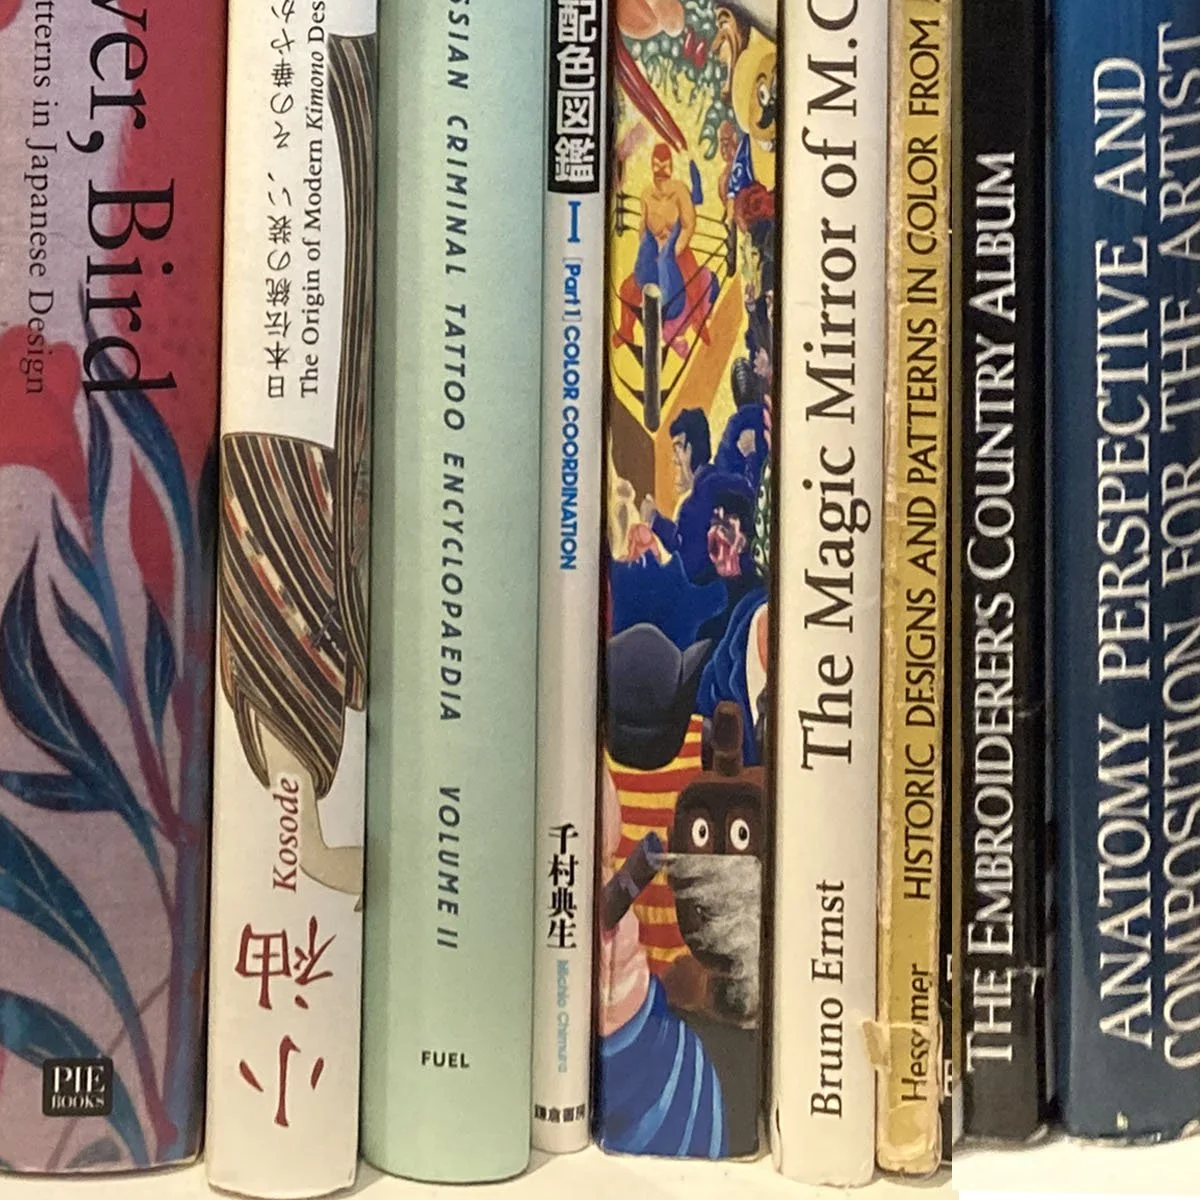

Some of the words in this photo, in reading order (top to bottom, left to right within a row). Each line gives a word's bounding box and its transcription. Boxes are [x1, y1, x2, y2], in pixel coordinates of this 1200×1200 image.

[32, 100, 58, 127] in
[305, 51, 325, 129] Kimono
[555, 0, 597, 183] 配色図鑑
[909, 17, 939, 117] FROM
[304, 138, 323, 230] Modern
[802, 128, 858, 198] of
[1093, 57, 1146, 205] AND
[1157, 21, 1200, 262] ARTIST
[24, 137, 57, 277] Japanese
[303, 236, 321, 264] of
[445, 115, 468, 275] CRIMINAL
[907, 134, 938, 255] COLOR
[969, 151, 1016, 321] ALBUM
[20, 290, 53, 394] Design
[82, 178, 177, 392] Bird
[302, 269, 325, 344] Origin
[802, 216, 858, 424] Mirror
[907, 266, 937, 305] IN
[300, 349, 318, 397] The
[443, 304, 466, 431] TATTOO
[563, 325, 580, 400] COLOR
[906, 316, 937, 485] PATTERNS
[1160, 295, 1200, 434] THE
[560, 406, 580, 570] COORDINATION
[967, 334, 1015, 581] COUNTRY
[1095, 236, 1150, 684] PERSPECTIVE
[440, 453, 465, 721] ENCYCLOPAEDIA
[802, 447, 871, 633] Magic
[906, 495, 936, 576] AND
[1161, 462, 1200, 588] FOR
[800, 658, 855, 771] The
[905, 587, 935, 727] DESIGNS
[274, 776, 300, 893] Kosode
[437, 786, 461, 916] VOLUME
[904, 743, 934, 900] HISTORIC
[1098, 713, 1153, 1048] ANATOMY
[1162, 621, 1200, 1070] COMPOSITION
[436, 930, 458, 949] II
[547, 823, 579, 949] 千村典生
[809, 878, 847, 985] Ernst
[52, 1065, 105, 1094] PIE
[234, 914, 339, 1128] 小袖
[421, 1050, 470, 1070] FUEL
[809, 997, 845, 1119] Bruno
[967, 967, 1012, 1072] THE
[51, 1095, 105, 1110] BOOKS
